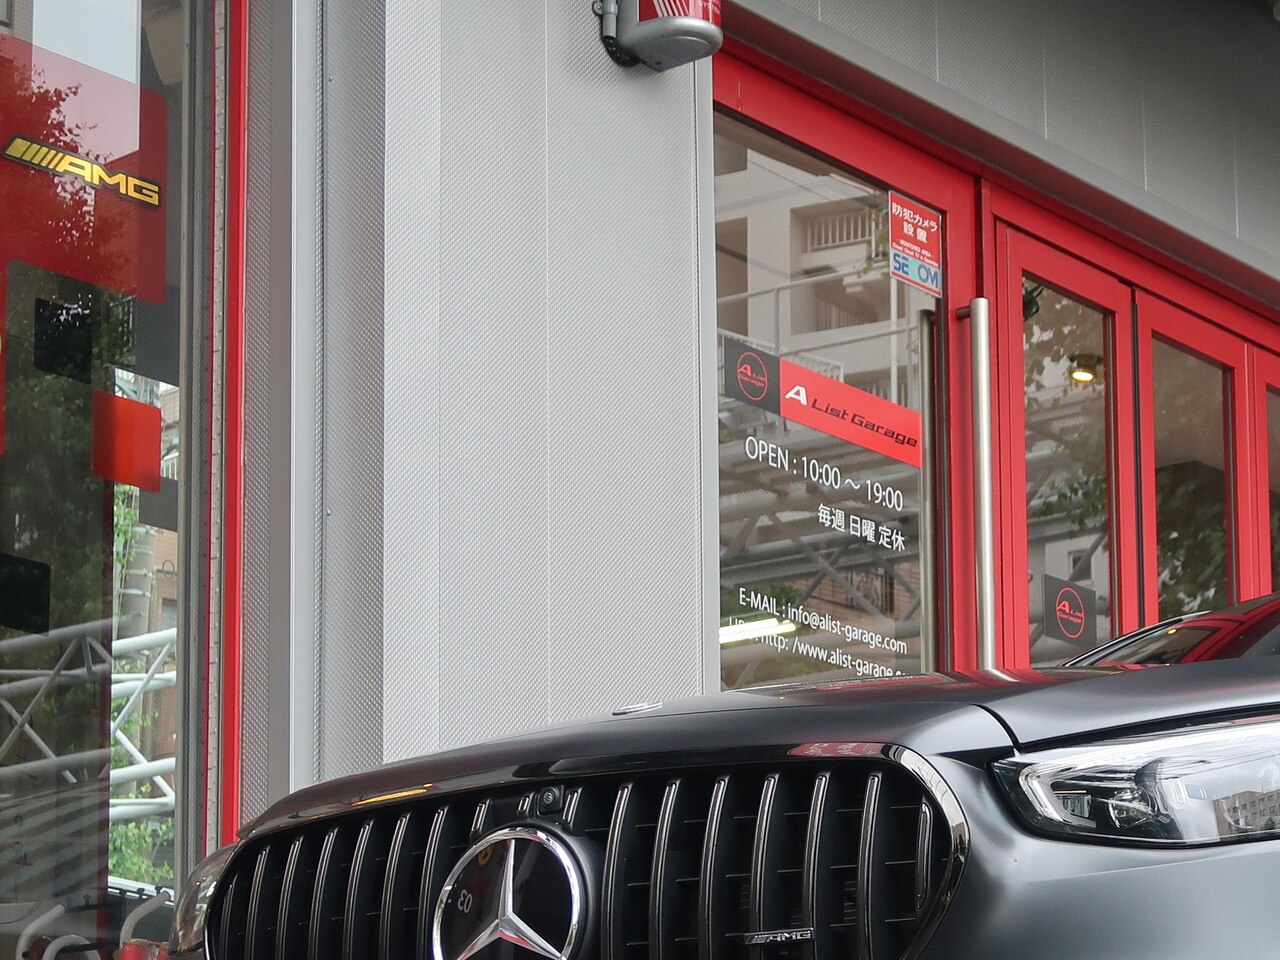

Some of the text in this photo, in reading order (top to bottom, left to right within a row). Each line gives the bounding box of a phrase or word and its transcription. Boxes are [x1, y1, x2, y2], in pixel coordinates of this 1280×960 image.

[56, 152, 161, 206] AMG
[892, 202, 938, 232] 防犯カメラ
[893, 252, 939, 288] SECOM
[784, 384, 918, 448] A List Garage
[744, 436, 789, 472] OPEN
[801, 456, 841, 490] 10:00
[865, 479, 903, 512] 19:00
[817, 502, 906, 553] 毎週 日曜 定休
[739, 587, 779, 614] E-MAIL
[788, 603, 908, 655] info@alist-garage.com
[766, 931, 811, 943] AMG
